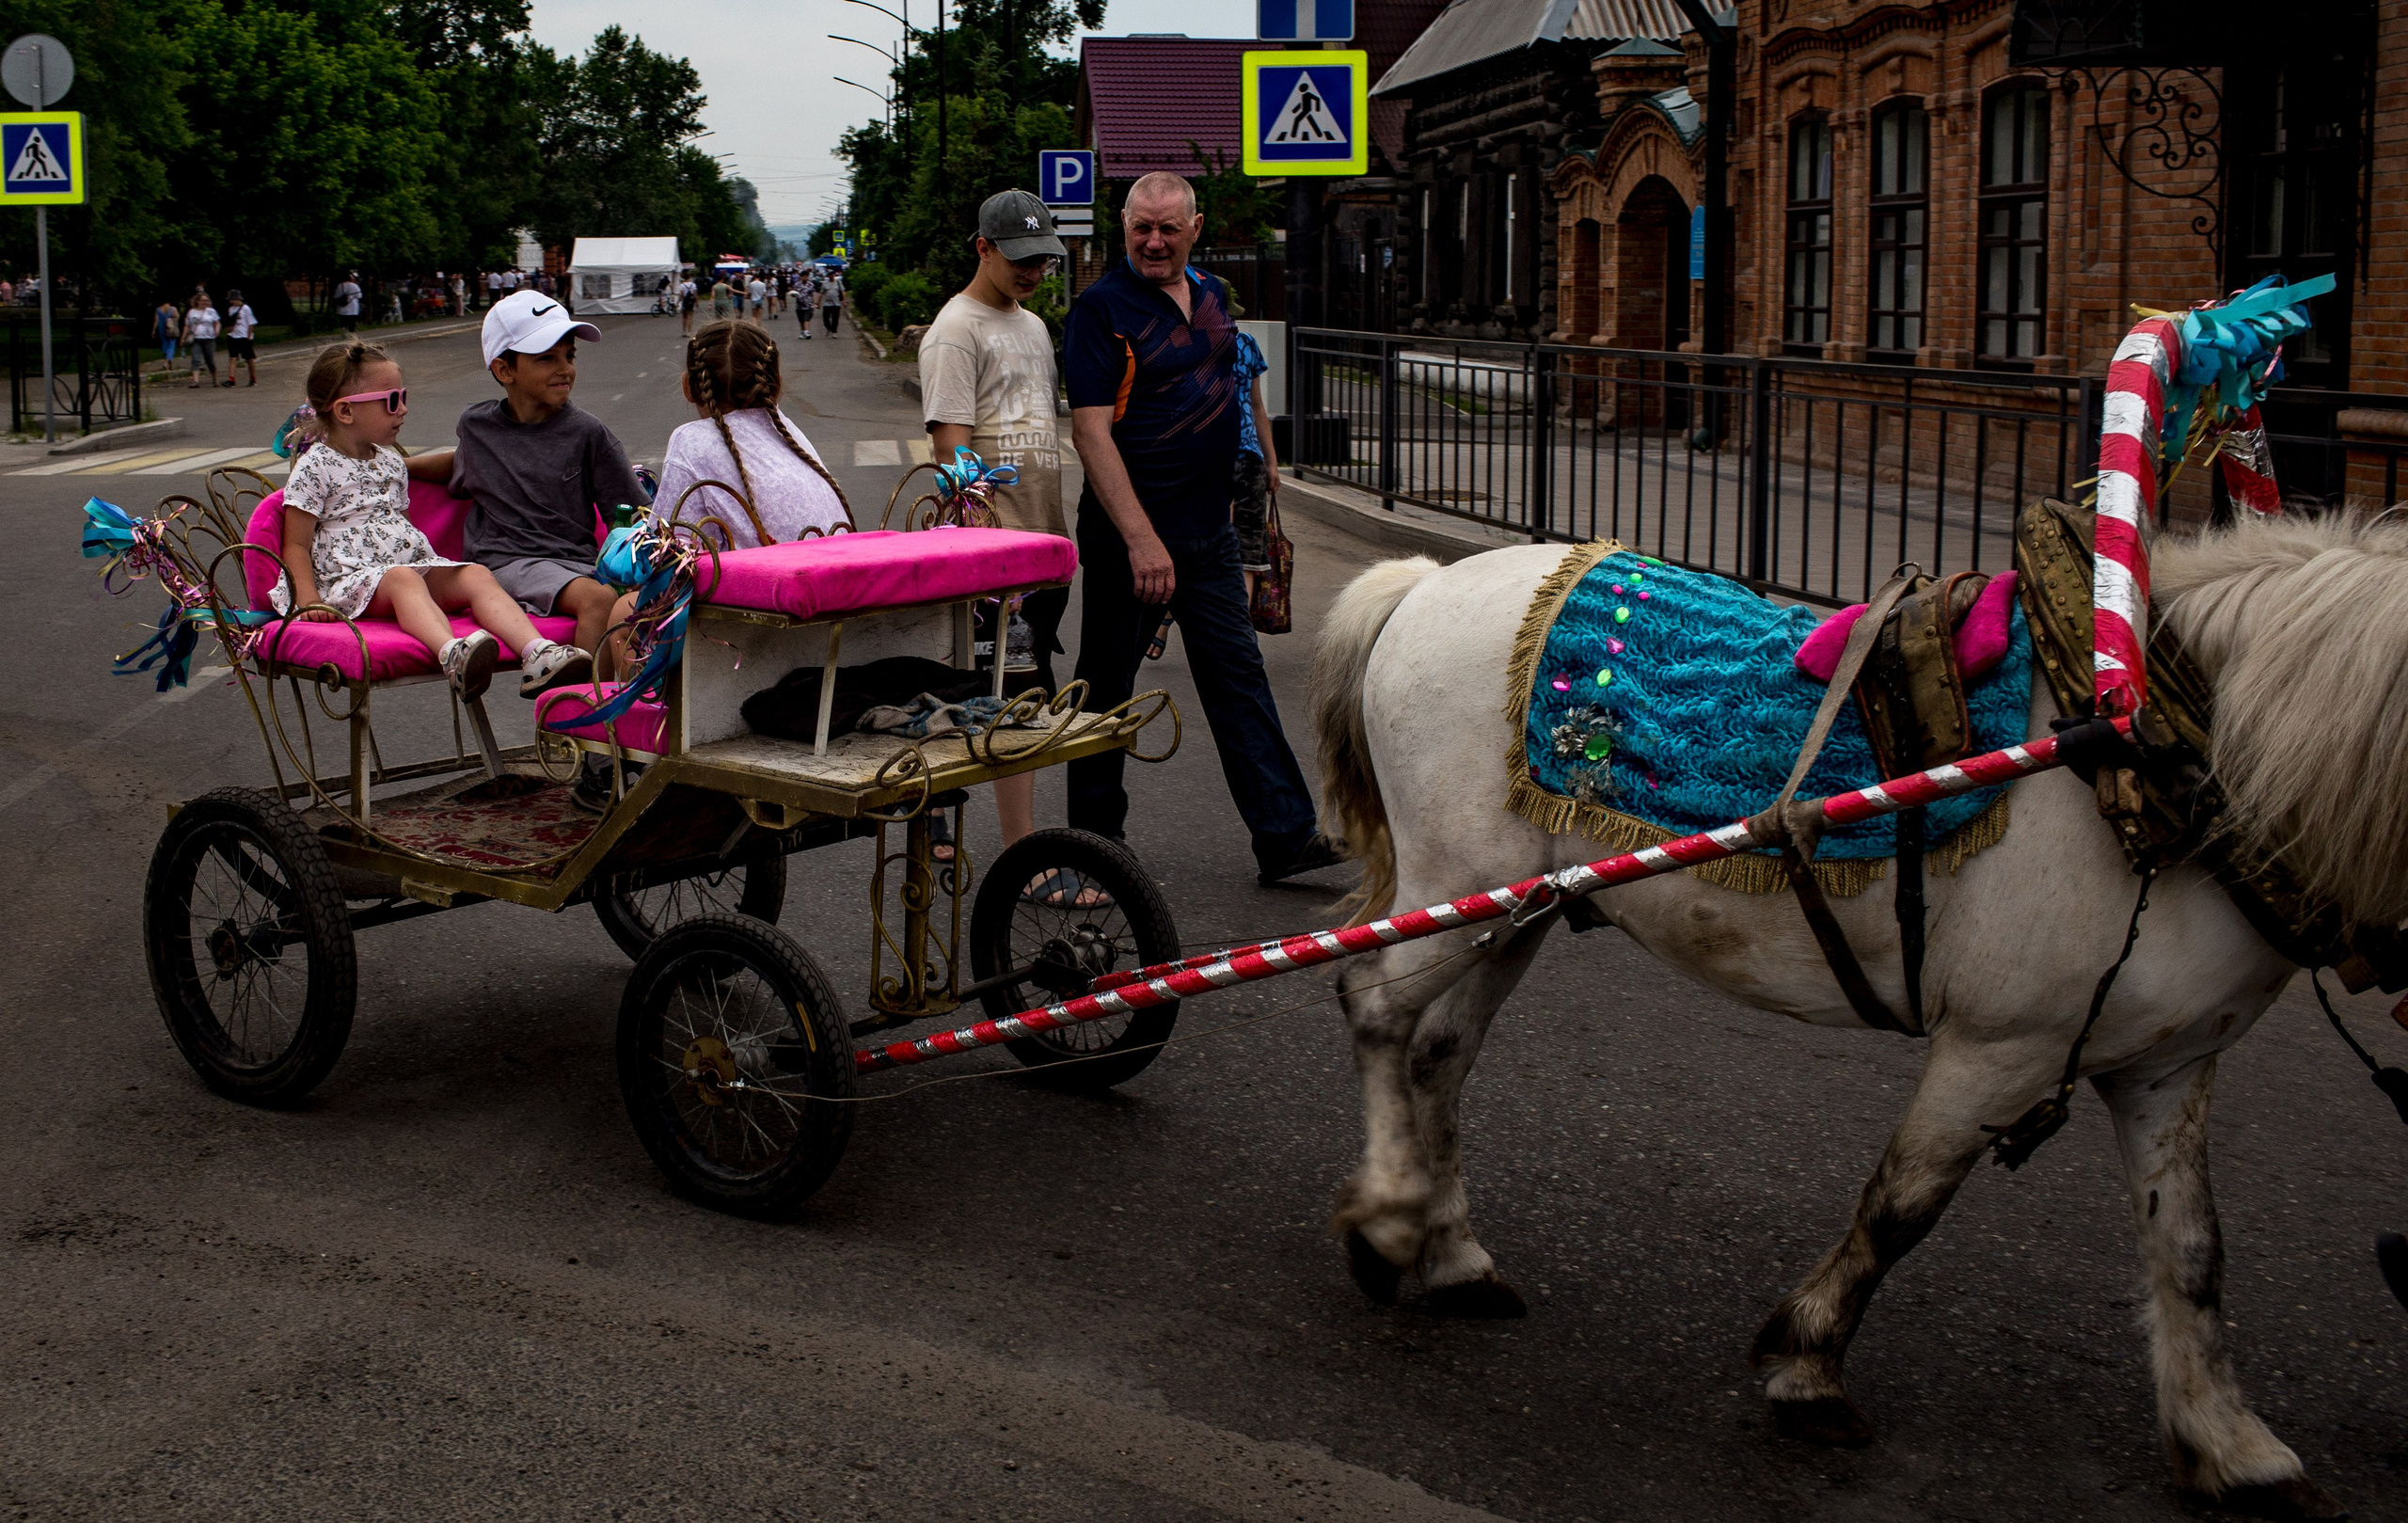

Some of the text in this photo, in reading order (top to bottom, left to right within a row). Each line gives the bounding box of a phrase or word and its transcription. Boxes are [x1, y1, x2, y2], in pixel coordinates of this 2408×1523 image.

[1054, 157, 1084, 198] P
[1024, 215, 1040, 230] NY
[998, 452, 1025, 467] DE
